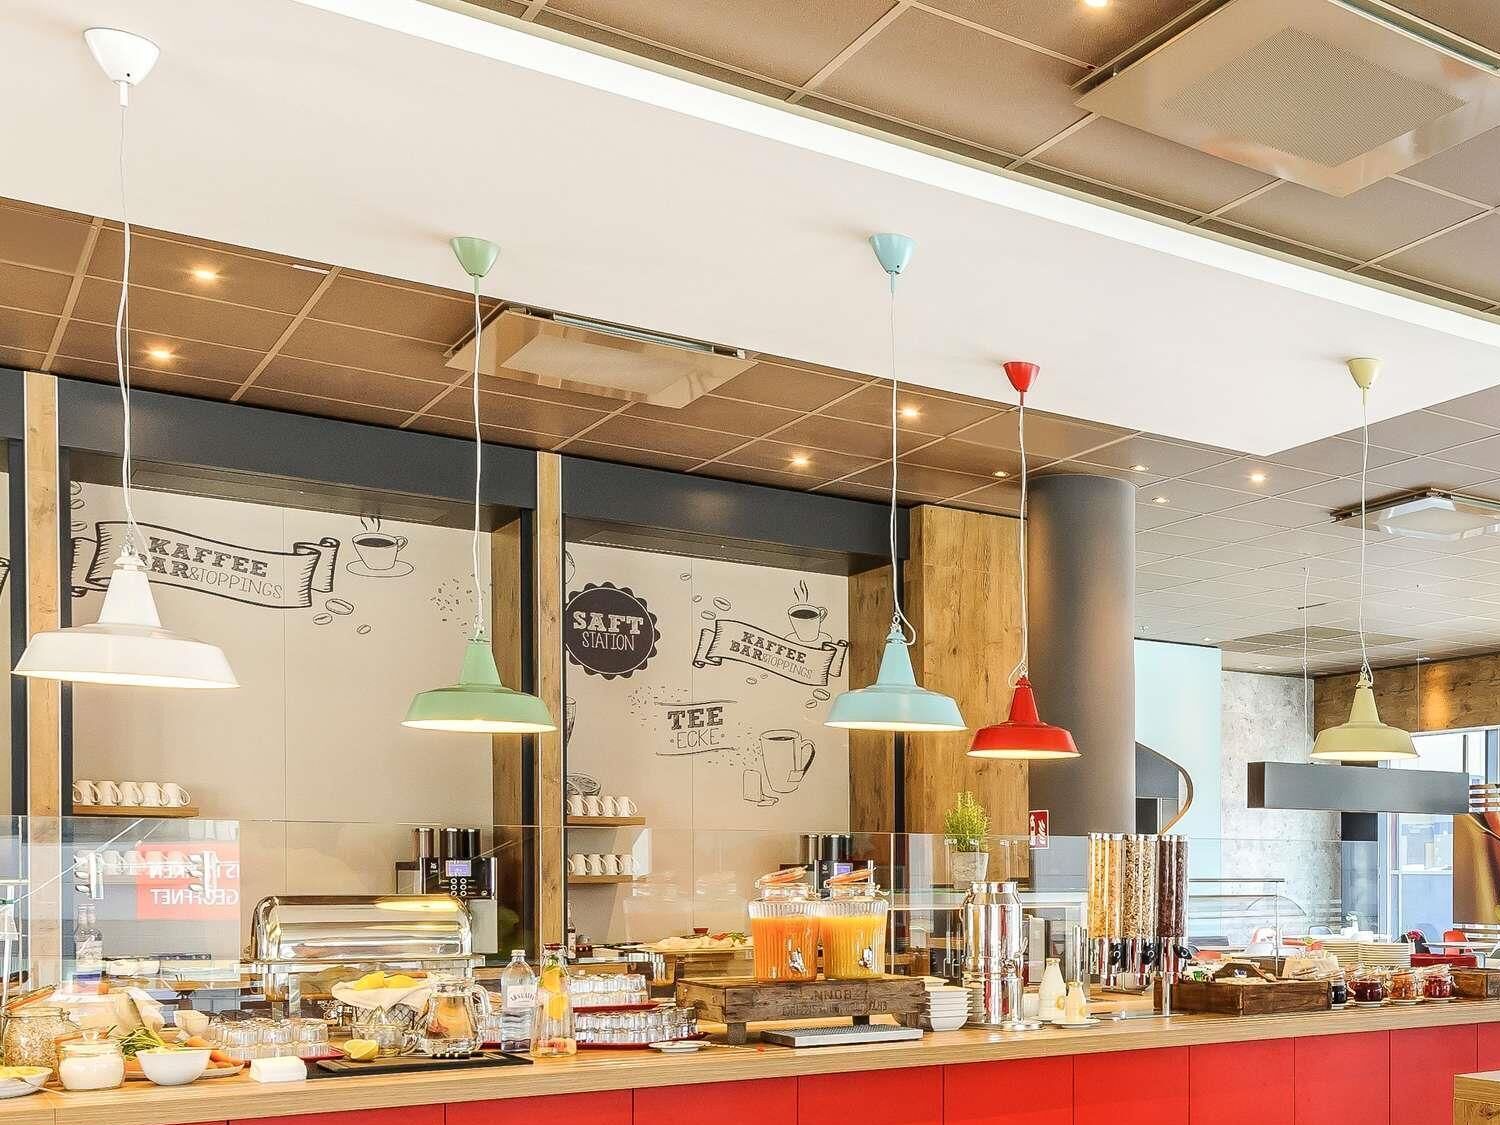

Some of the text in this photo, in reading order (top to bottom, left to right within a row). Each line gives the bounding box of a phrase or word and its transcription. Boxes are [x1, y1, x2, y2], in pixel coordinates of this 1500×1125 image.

[149, 536, 268, 578] KAFFEE
[573, 610, 644, 635] SAFT
[582, 630, 635, 651] STATION
[740, 631, 807, 664] KAFFEE
[667, 706, 723, 730] TEE
[677, 727, 720, 749] ECKE
